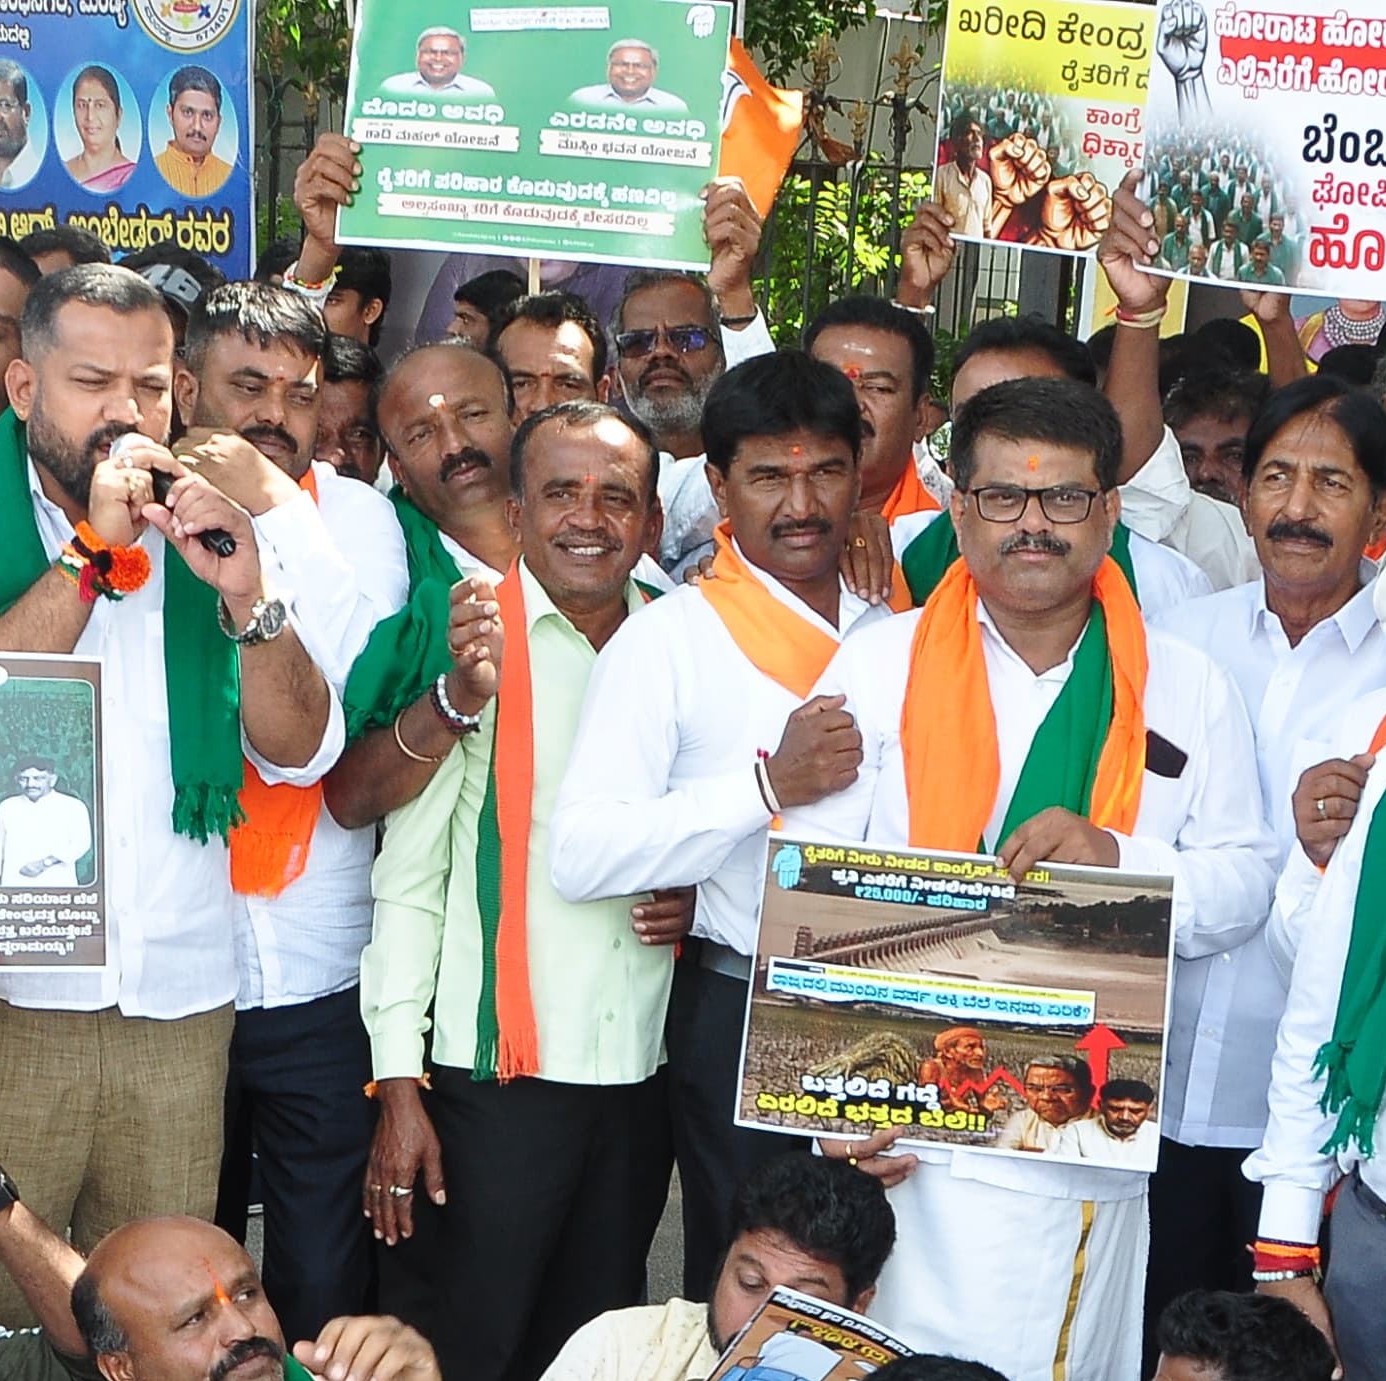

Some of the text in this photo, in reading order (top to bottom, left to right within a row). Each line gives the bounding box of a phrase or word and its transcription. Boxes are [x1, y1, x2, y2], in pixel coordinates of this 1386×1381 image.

[958, 6, 1046, 41] ಖರೀದಿ
[1215, 1, 1317, 46] ಹೋರಾಟ
[1061, 60, 1131, 91] ರೈತರಿಗೆ
[1217, 55, 1313, 99] ಎಲ್ಲಿವರೆಗೆ
[363, 98, 504, 124] ಮೊದಲ ಅವಧಿ
[550, 111, 705, 141] ಎರಡನೇ ಅವಧಿ
[378, 167, 430, 193] ರೈತರಿಗೆ
[434, 174, 502, 196] ಪರಿಹಾರ
[176, 211, 230, 253] ರವರ
[849, 849, 882, 866] ನೀರು
[933, 861, 993, 879] ಕಾಂಗ್ರೆಸ್
[830, 980, 889, 998] ಮುಂದಿನ
[963, 995, 990, 1008] ಬೆಲೆ
[757, 1092, 839, 1118] ಏರಲಿದೆ
[844, 1101, 912, 1129] ಭತ್ತದ
